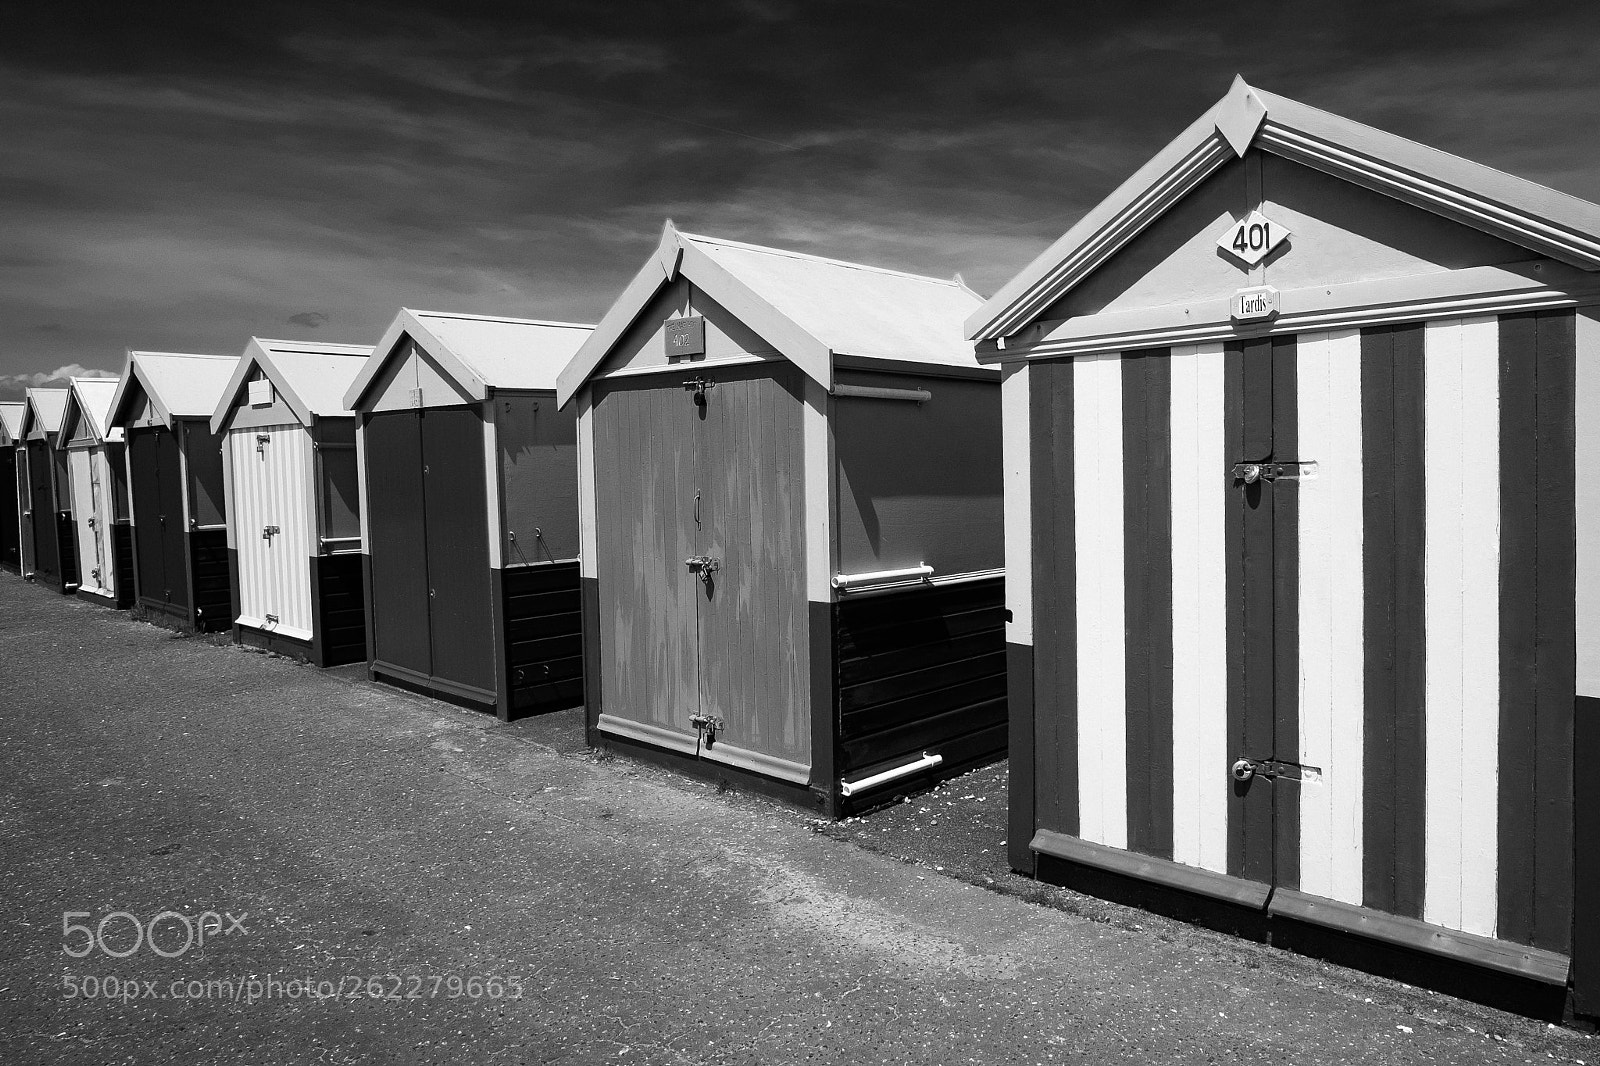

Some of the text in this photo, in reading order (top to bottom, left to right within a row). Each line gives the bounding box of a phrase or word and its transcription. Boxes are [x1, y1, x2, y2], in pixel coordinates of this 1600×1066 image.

[1232, 222, 1270, 253] 401
[1240, 294, 1267, 314] Tardis
[673, 333, 690, 347] 402
